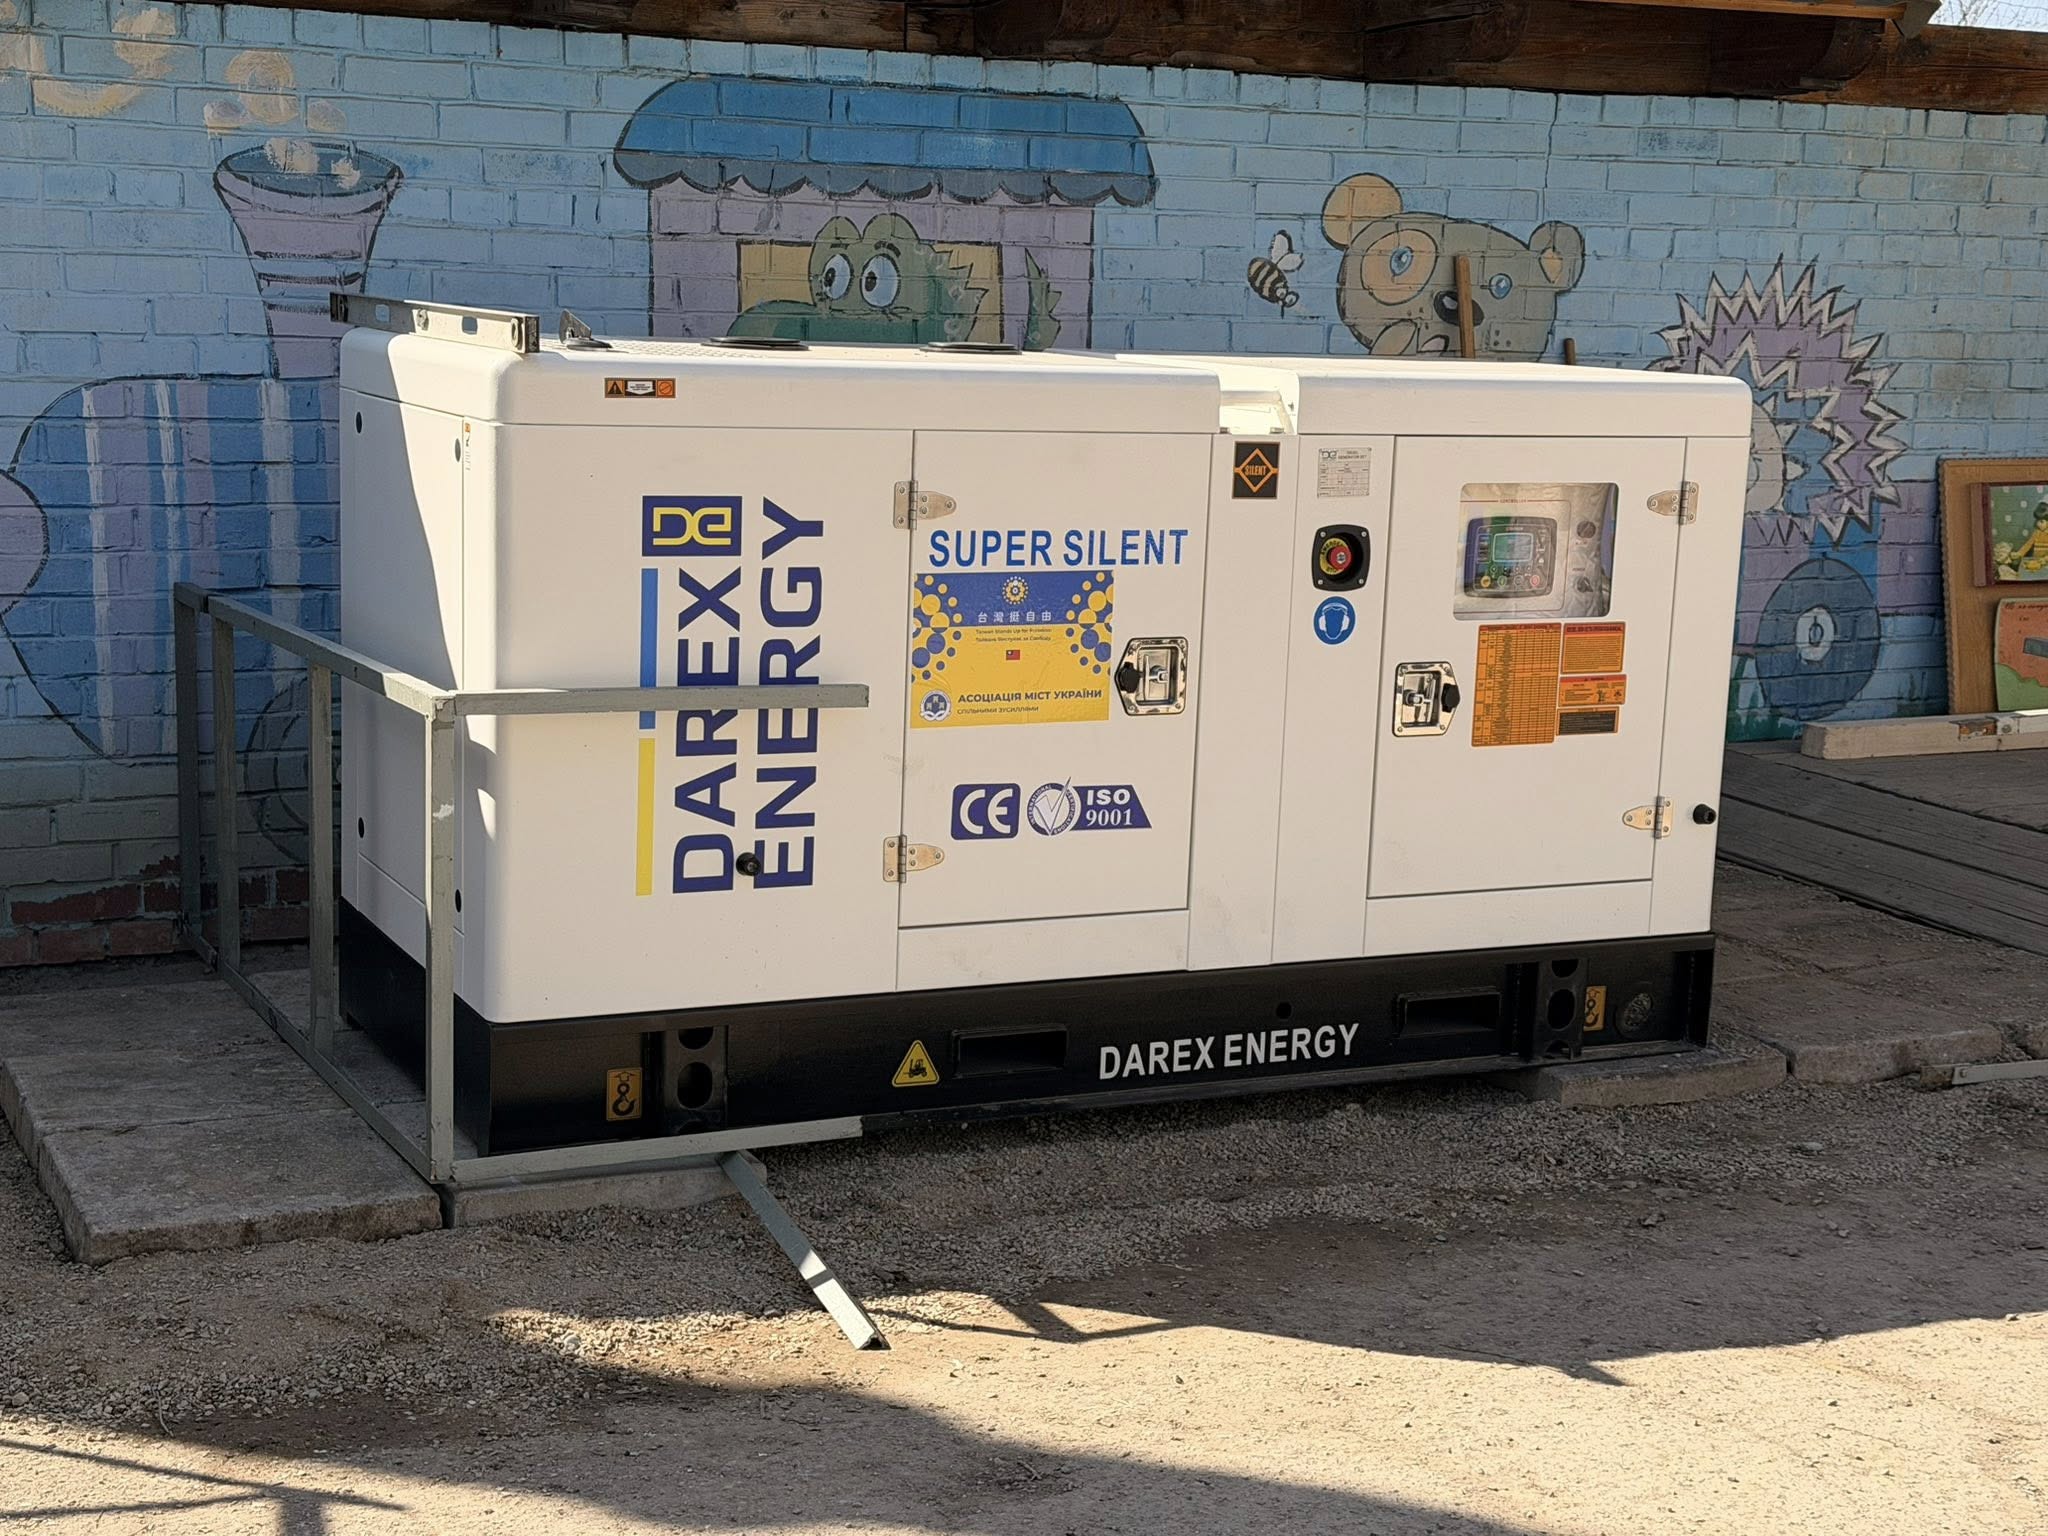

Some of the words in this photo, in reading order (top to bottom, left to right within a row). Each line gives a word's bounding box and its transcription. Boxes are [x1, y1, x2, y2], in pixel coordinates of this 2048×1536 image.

[1244, 464, 1267, 476] SILENT
[929, 530, 1052, 567] SUPER
[1063, 529, 1188, 566] SILENT
[978, 609, 1052, 623] 台灣挺自由
[753, 496, 824, 889] ENERGY
[958, 692, 1022, 703] АСОЦІАЦІЯ
[1025, 691, 1051, 700] МІСТ
[1054, 689, 1102, 700] УКРАЇНИ
[673, 566, 742, 893] DAREX
[959, 788, 1013, 835] CE
[1086, 789, 1131, 806] ISO
[1085, 808, 1133, 827] 9001
[1099, 1036, 1215, 1080] DAREX
[1223, 1023, 1359, 1067] ENERGY
